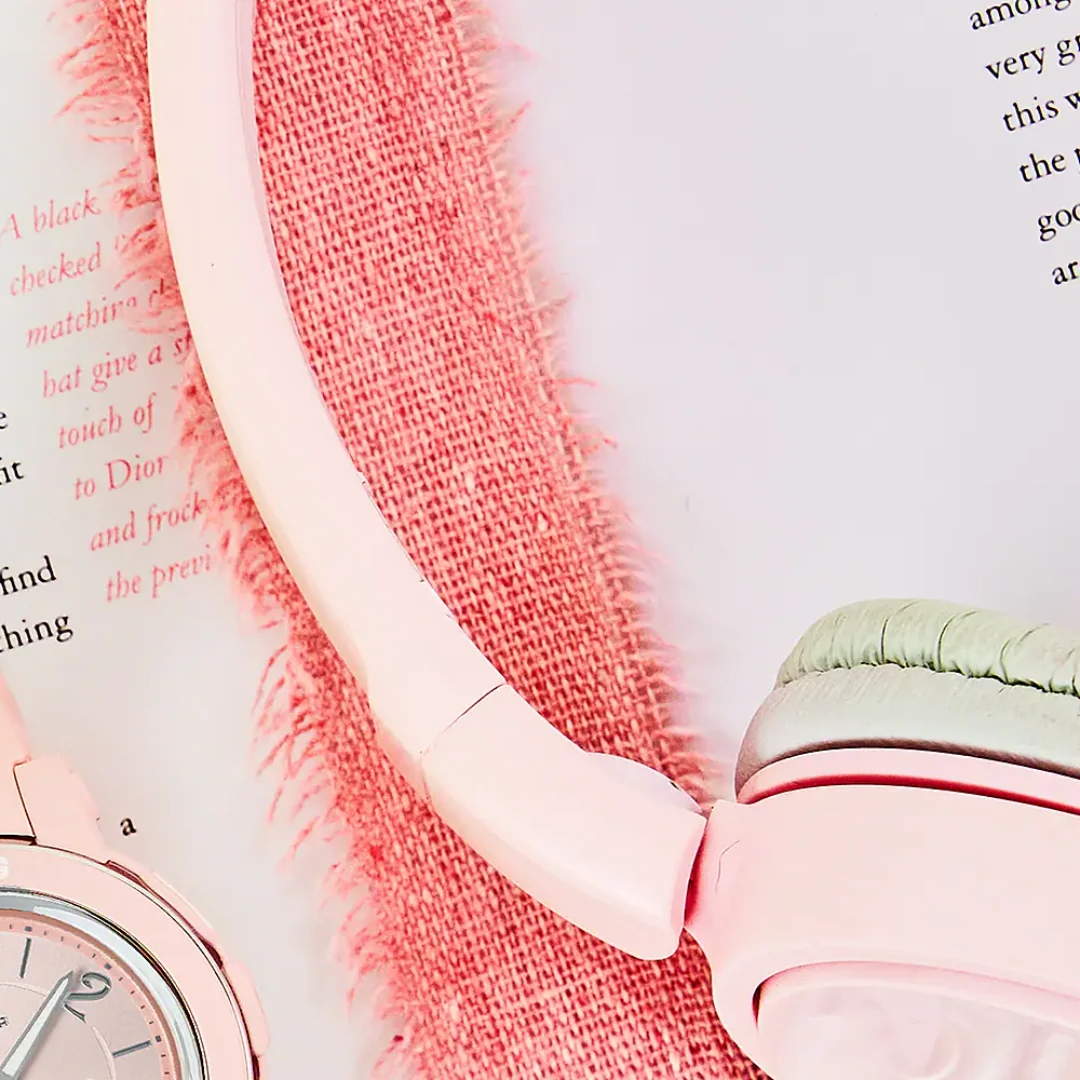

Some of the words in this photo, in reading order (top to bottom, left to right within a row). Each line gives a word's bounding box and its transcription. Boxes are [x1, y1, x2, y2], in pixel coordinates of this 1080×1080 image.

[985, 46, 1046, 80] very
[1003, 96, 1060, 132] this
[1019, 152, 1067, 183] the
[33, 189, 101, 233] black
[9, 242, 101, 297] checked
[41, 364, 83, 399] hat
[89, 349, 140, 393] give
[146, 344, 163, 367] a
[58, 406, 124, 450] touch
[133, 392, 157, 431] of
[73, 477, 98, 502] to
[105, 455, 168, 491] Dior
[88, 508, 139, 553] and
[105, 568, 143, 604] the
